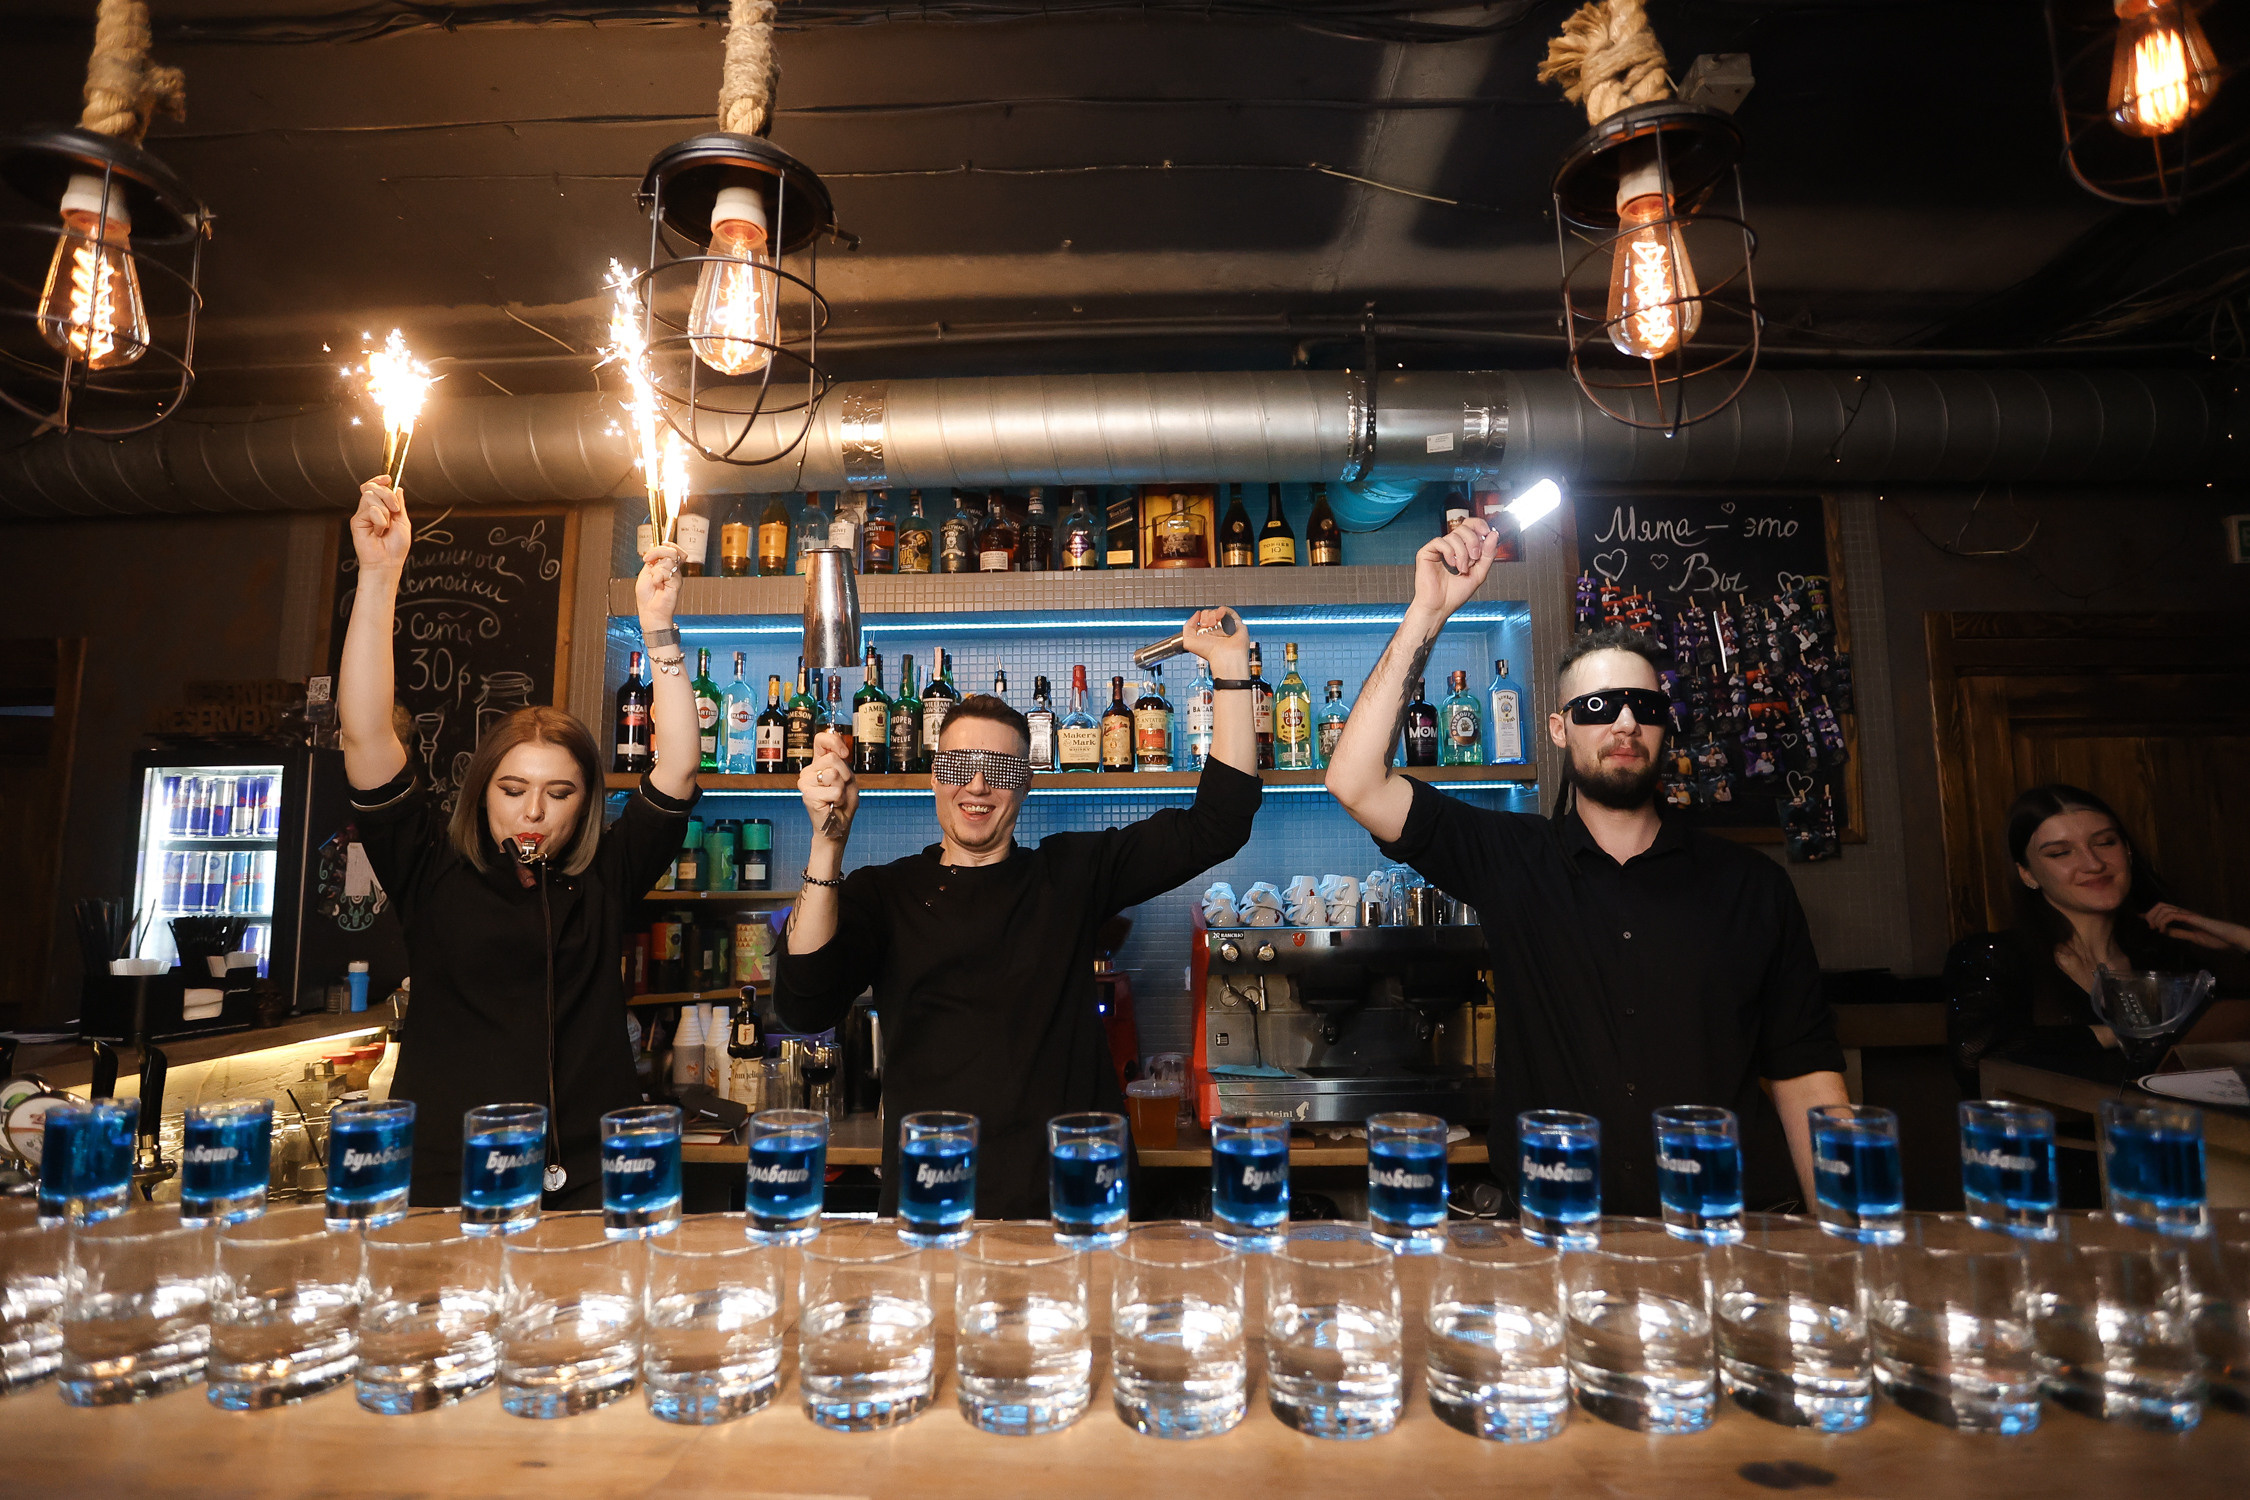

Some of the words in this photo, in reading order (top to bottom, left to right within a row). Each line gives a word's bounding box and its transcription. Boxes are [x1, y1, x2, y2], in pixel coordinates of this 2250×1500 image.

[1595, 506, 1706, 546] Мята
[1744, 517, 1799, 538] это
[1669, 552, 1749, 593] Вы
[622, 705, 644, 713] CINZA
[1409, 727, 1438, 739] MOM
[1265, 1110, 1294, 1118] Meinl
